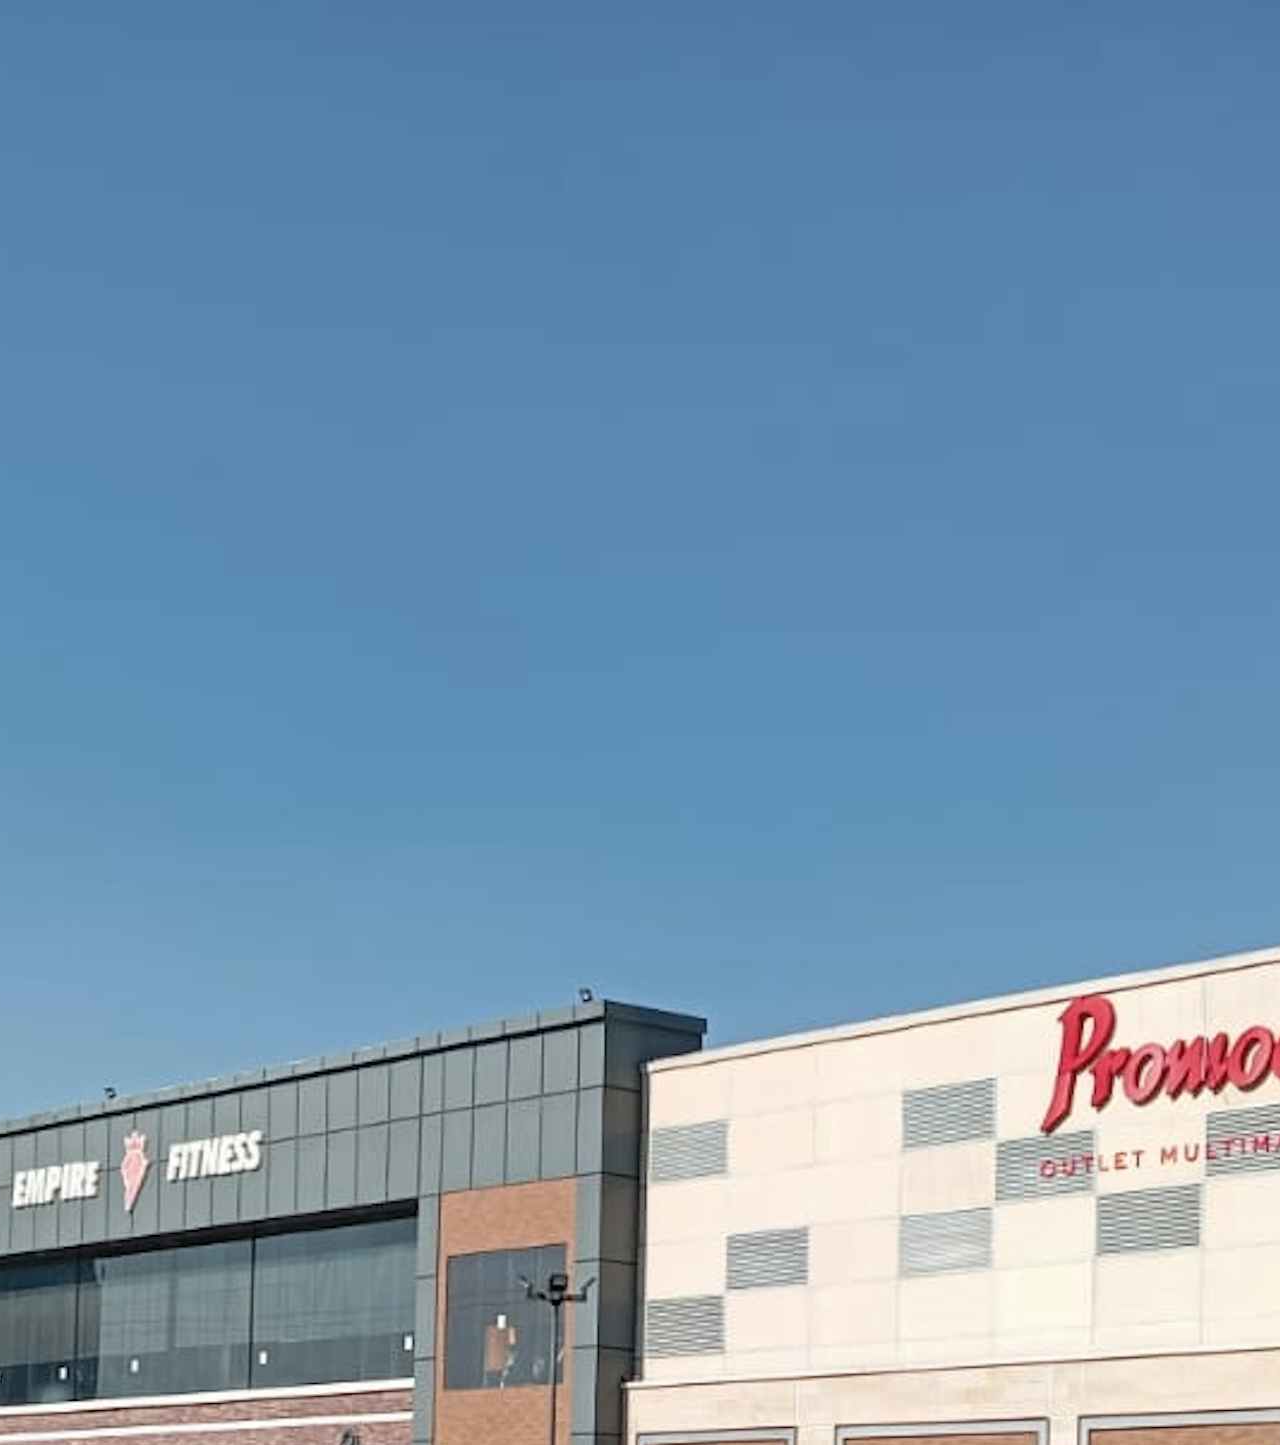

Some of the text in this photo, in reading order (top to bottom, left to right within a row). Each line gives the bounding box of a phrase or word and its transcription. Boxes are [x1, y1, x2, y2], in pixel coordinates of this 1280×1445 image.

[12, 1129, 265, 1208] EMPIRE FITNESS
[1039, 1149, 1146, 1180] OUTLET
